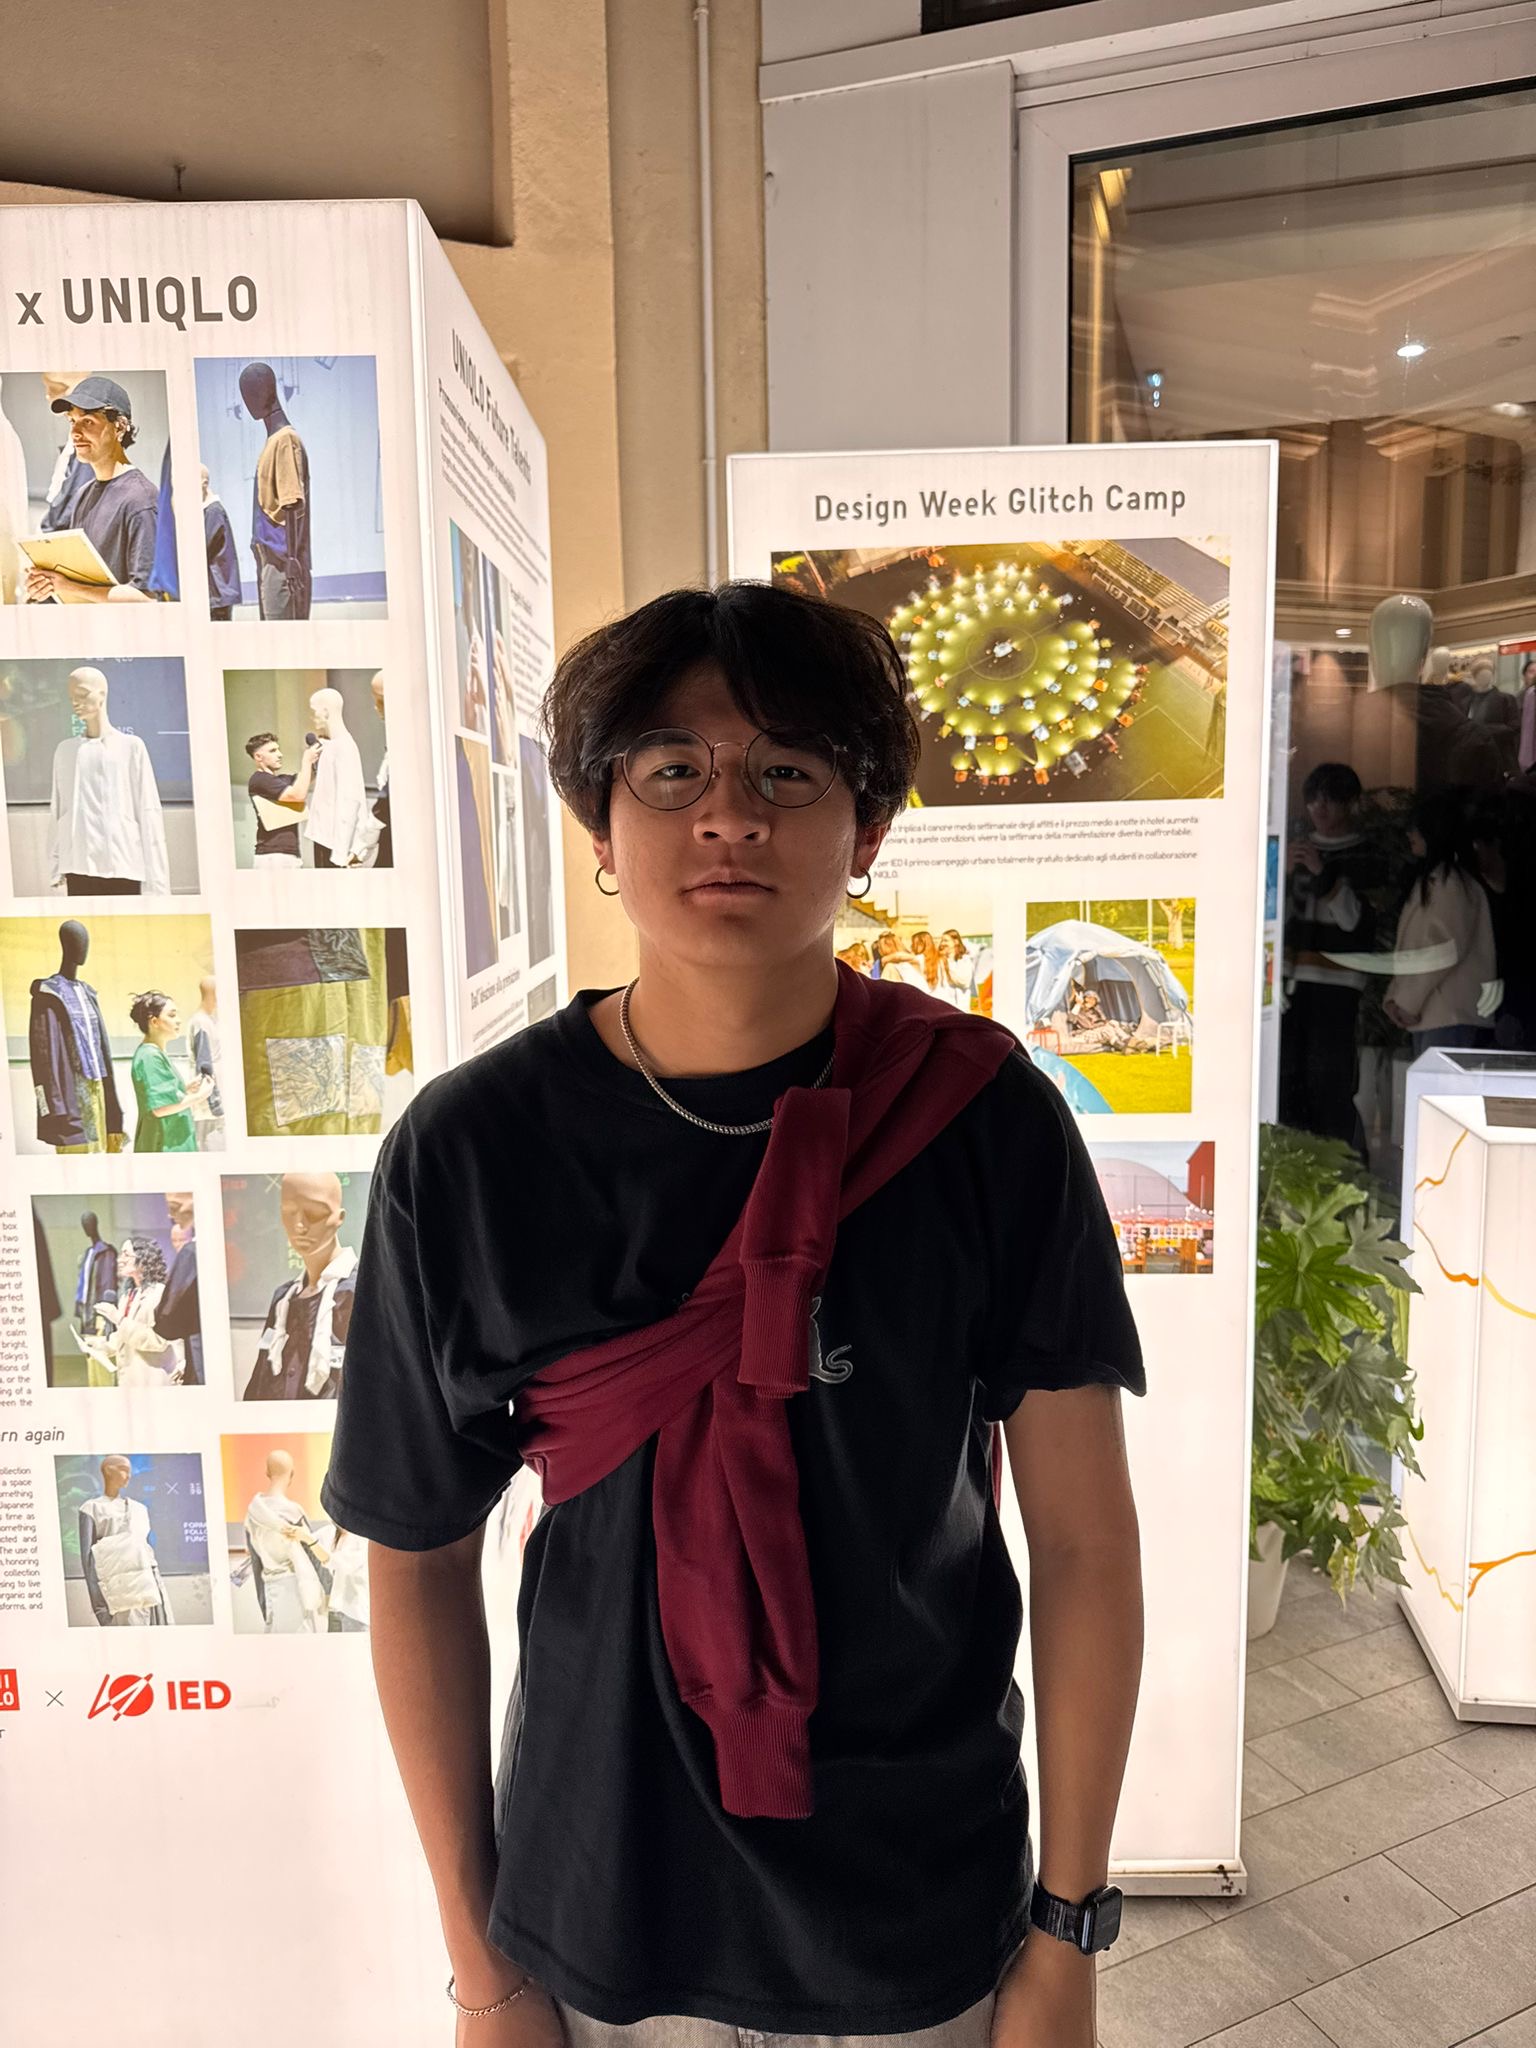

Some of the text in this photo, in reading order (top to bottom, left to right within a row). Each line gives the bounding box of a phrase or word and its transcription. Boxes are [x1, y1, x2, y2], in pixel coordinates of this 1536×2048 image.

[15, 275, 258, 331] x UNIQLO
[452, 328, 532, 486] UNIQLO Future Talents
[815, 484, 1186, 528] Design Week Glitch Camp
[954, 822, 976, 831] medio
[977, 821, 1018, 831] settimanale
[1018, 819, 1035, 831] degli
[1065, 820, 1090, 830] prezzo
[1090, 818, 1113, 828] medio
[1119, 817, 1138, 827] notte
[1146, 816, 1165, 826] hotel
[1166, 815, 1199, 825] aumenta
[916, 835, 939, 845] queste
[977, 833, 999, 842] vivere
[1007, 831, 1043, 841] settimana
[1044, 830, 1061, 840] della
[1062, 829, 1116, 840] manifestazione
[1117, 828, 1143, 839] diventa
[877, 861, 890, 869] per
[908, 858, 930, 868] primo
[931, 857, 969, 868] campeggio
[970, 856, 996, 865] urbano
[997, 855, 1035, 865] totalmente
[1035, 854, 1064, 866] gratuito
[1064, 853, 1095, 863] dedicato
[1095, 853, 1108, 864] agli
[1109, 852, 1137, 862] studenti
[1145, 850, 1198, 860] collaborazione
[2, 1221, 18, 1231] box
[2, 1233, 20, 1243] two
[2, 1246, 20, 1255] new
[14, 1281, 23, 1290] of
[11, 1304, 25, 1314] the
[1, 1315, 26, 1326] life of
[6, 1328, 27, 1338] calm
[20, 1362, 30, 1372] of
[6, 1375, 16, 1384] or
[17, 1375, 32, 1384] the
[15, 1385, 24, 1395] of
[26, 1387, 33, 1395] a
[19, 1398, 34, 1407] the
[25, 1426, 66, 1446] again
[1, 1479, 33, 1489] a space
[5, 1513, 24, 1521] time
[26, 1513, 36, 1521] as
[22, 1535, 38, 1544] and
[15, 1547, 28, 1555] use
[30, 1545, 39, 1555] of
[3, 1569, 41, 1578] collection
[17, 1580, 27, 1588] to
[28, 1579, 42, 1588] live
[28, 1590, 43, 1600] and
[29, 1601, 44, 1611] and
[167, 1680, 231, 1710] IED
